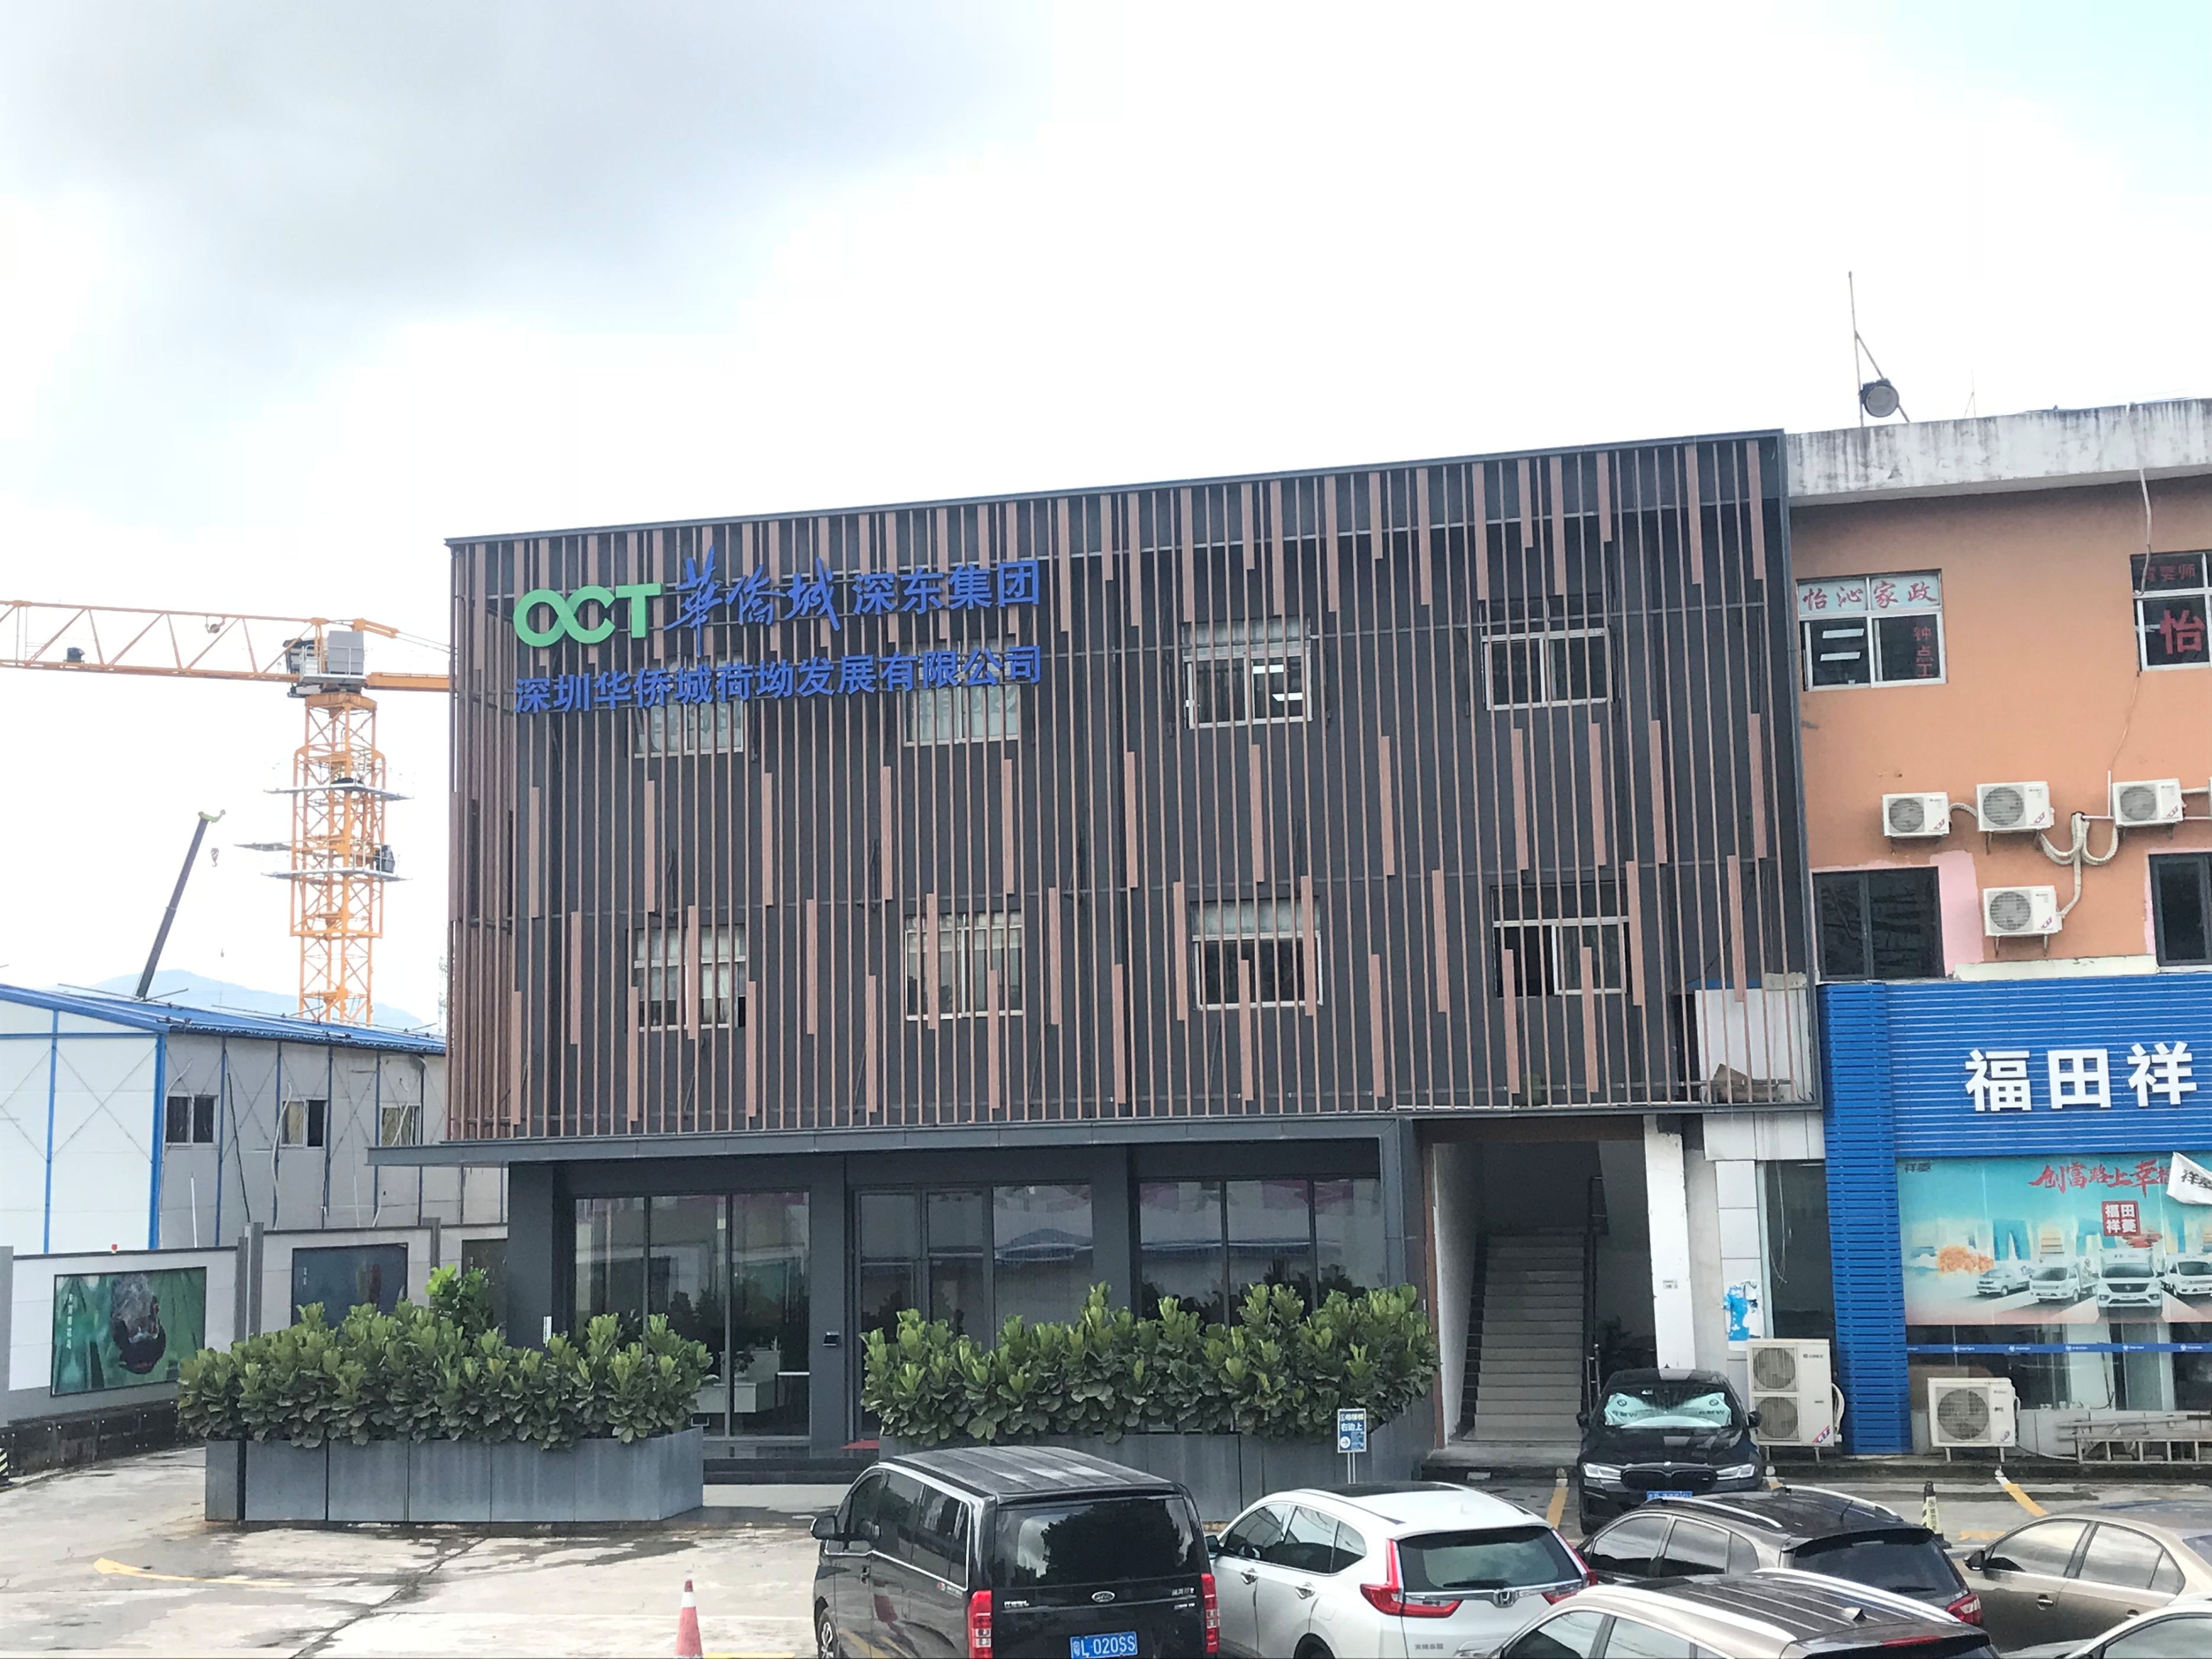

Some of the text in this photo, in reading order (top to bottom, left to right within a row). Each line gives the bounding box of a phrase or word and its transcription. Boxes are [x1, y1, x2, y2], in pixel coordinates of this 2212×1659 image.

[513, 583, 661, 647] OCT
[852, 559, 1039, 615] 深东集团
[1803, 580, 1937, 611] 怡沁家政
[1913, 626, 1934, 677] 钟点工
[2160, 609, 2205, 654] 怡
[515, 645, 1041, 714] 深圳华侨城荷坳发展有限公司
[1965, 1041, 2197, 1112] 福田祥
